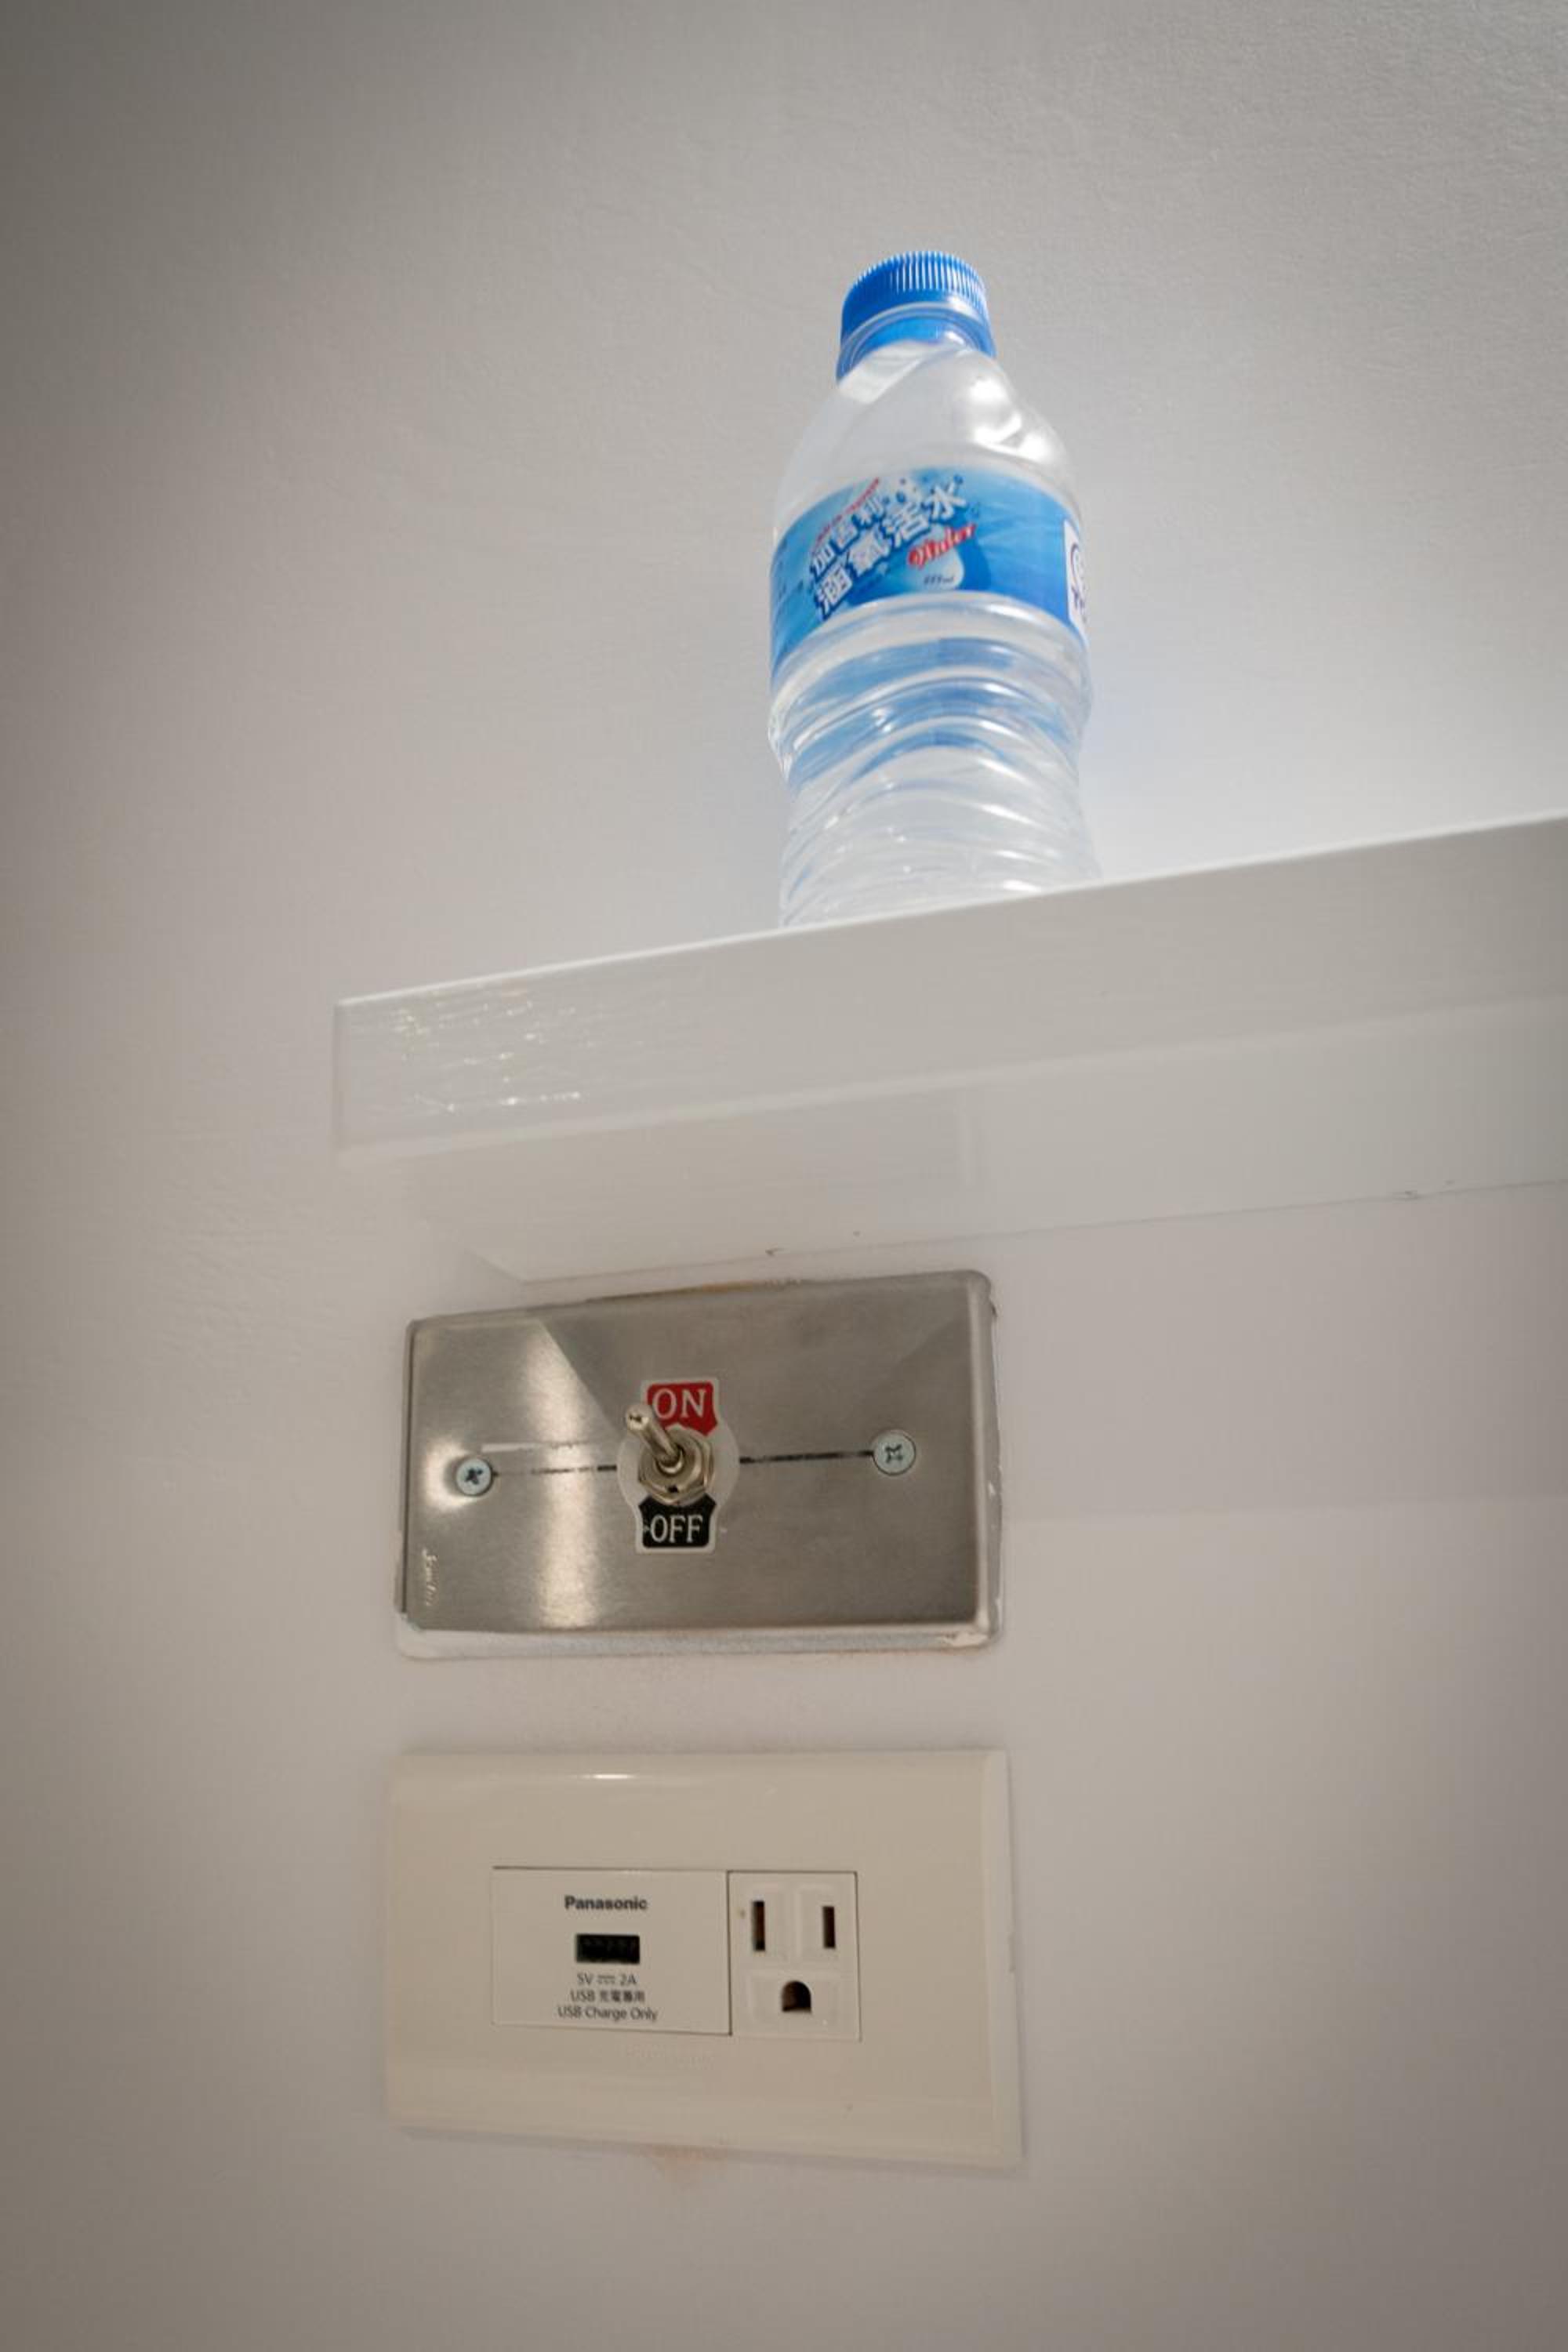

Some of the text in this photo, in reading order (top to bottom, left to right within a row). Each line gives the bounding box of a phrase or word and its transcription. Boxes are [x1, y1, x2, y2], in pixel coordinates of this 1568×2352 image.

[652, 1387, 707, 1420] ON
[650, 1514, 704, 1544] OFF
[564, 1894, 648, 1910] Panasonic
[619, 1973, 637, 1986] 2A
[570, 1989, 596, 2002] USB
[557, 2006, 658, 2023] USB Charge Only
